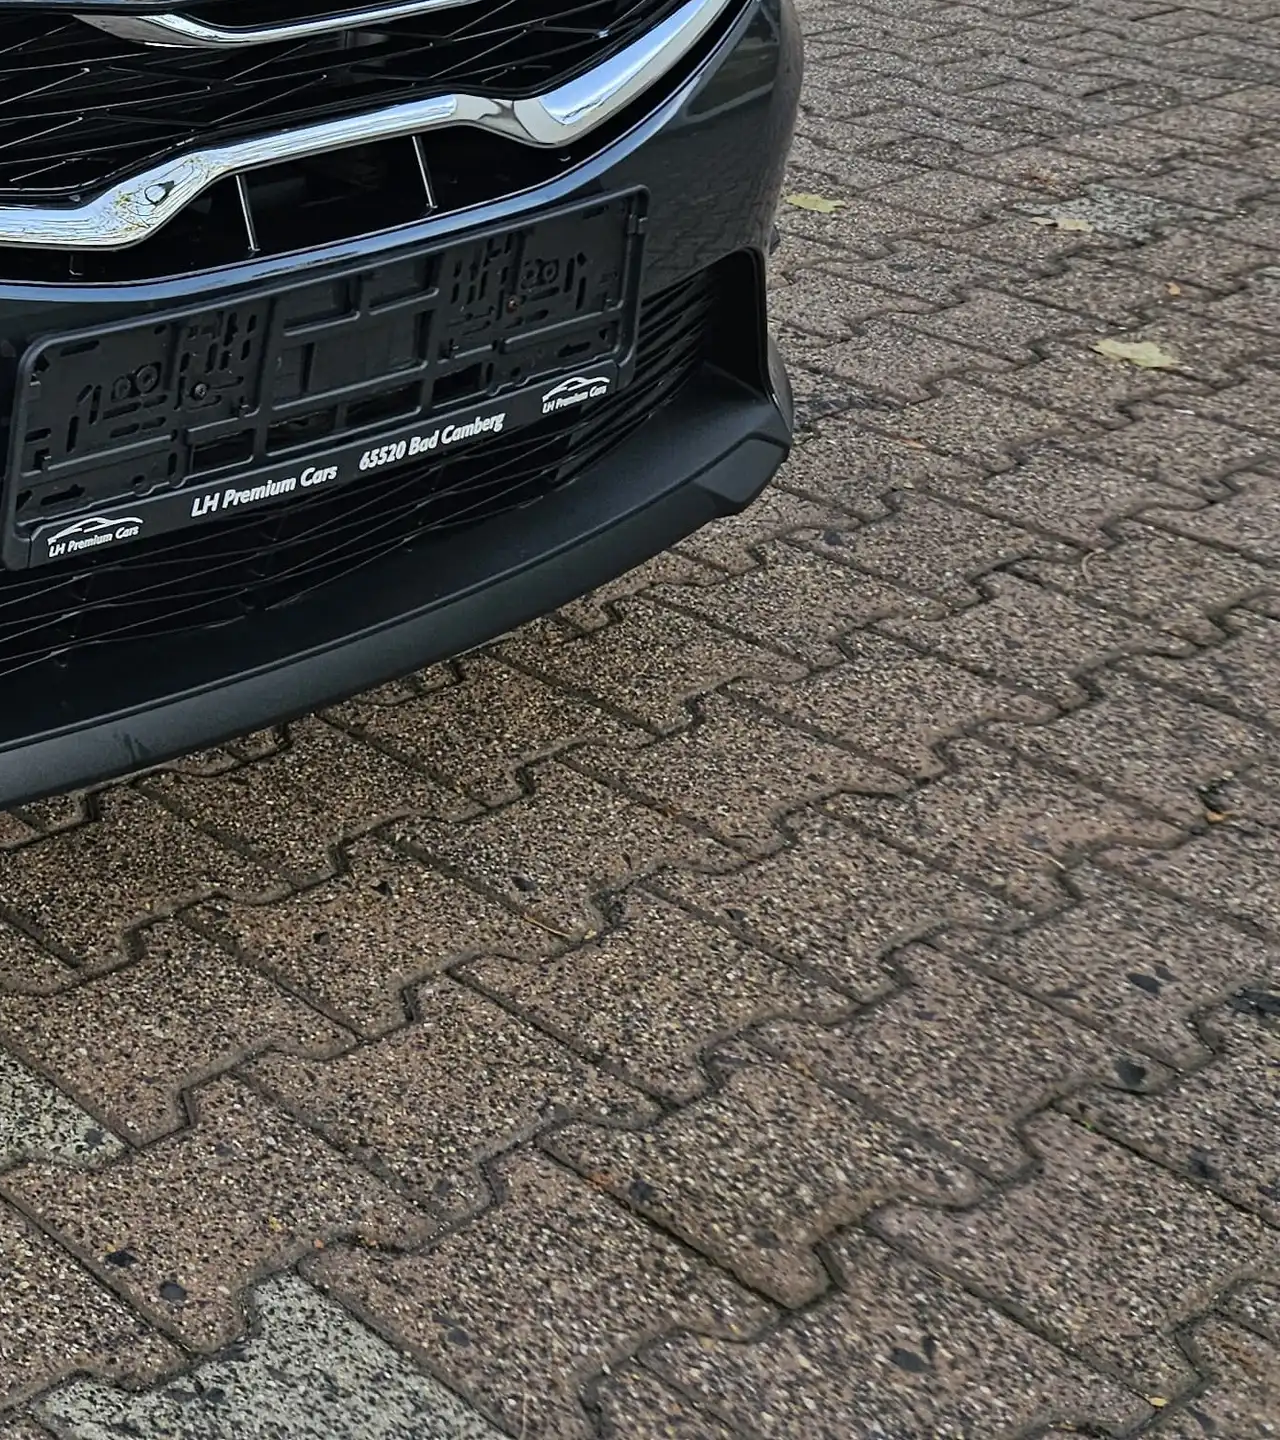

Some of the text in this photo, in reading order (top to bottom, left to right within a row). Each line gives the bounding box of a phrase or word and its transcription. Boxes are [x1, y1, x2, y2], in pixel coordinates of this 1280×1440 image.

[359, 412, 506, 471] 65520 Bad Camberg
[191, 466, 338, 517] LH Premium Cars
[48, 525, 139, 558] LH Premium Cars
